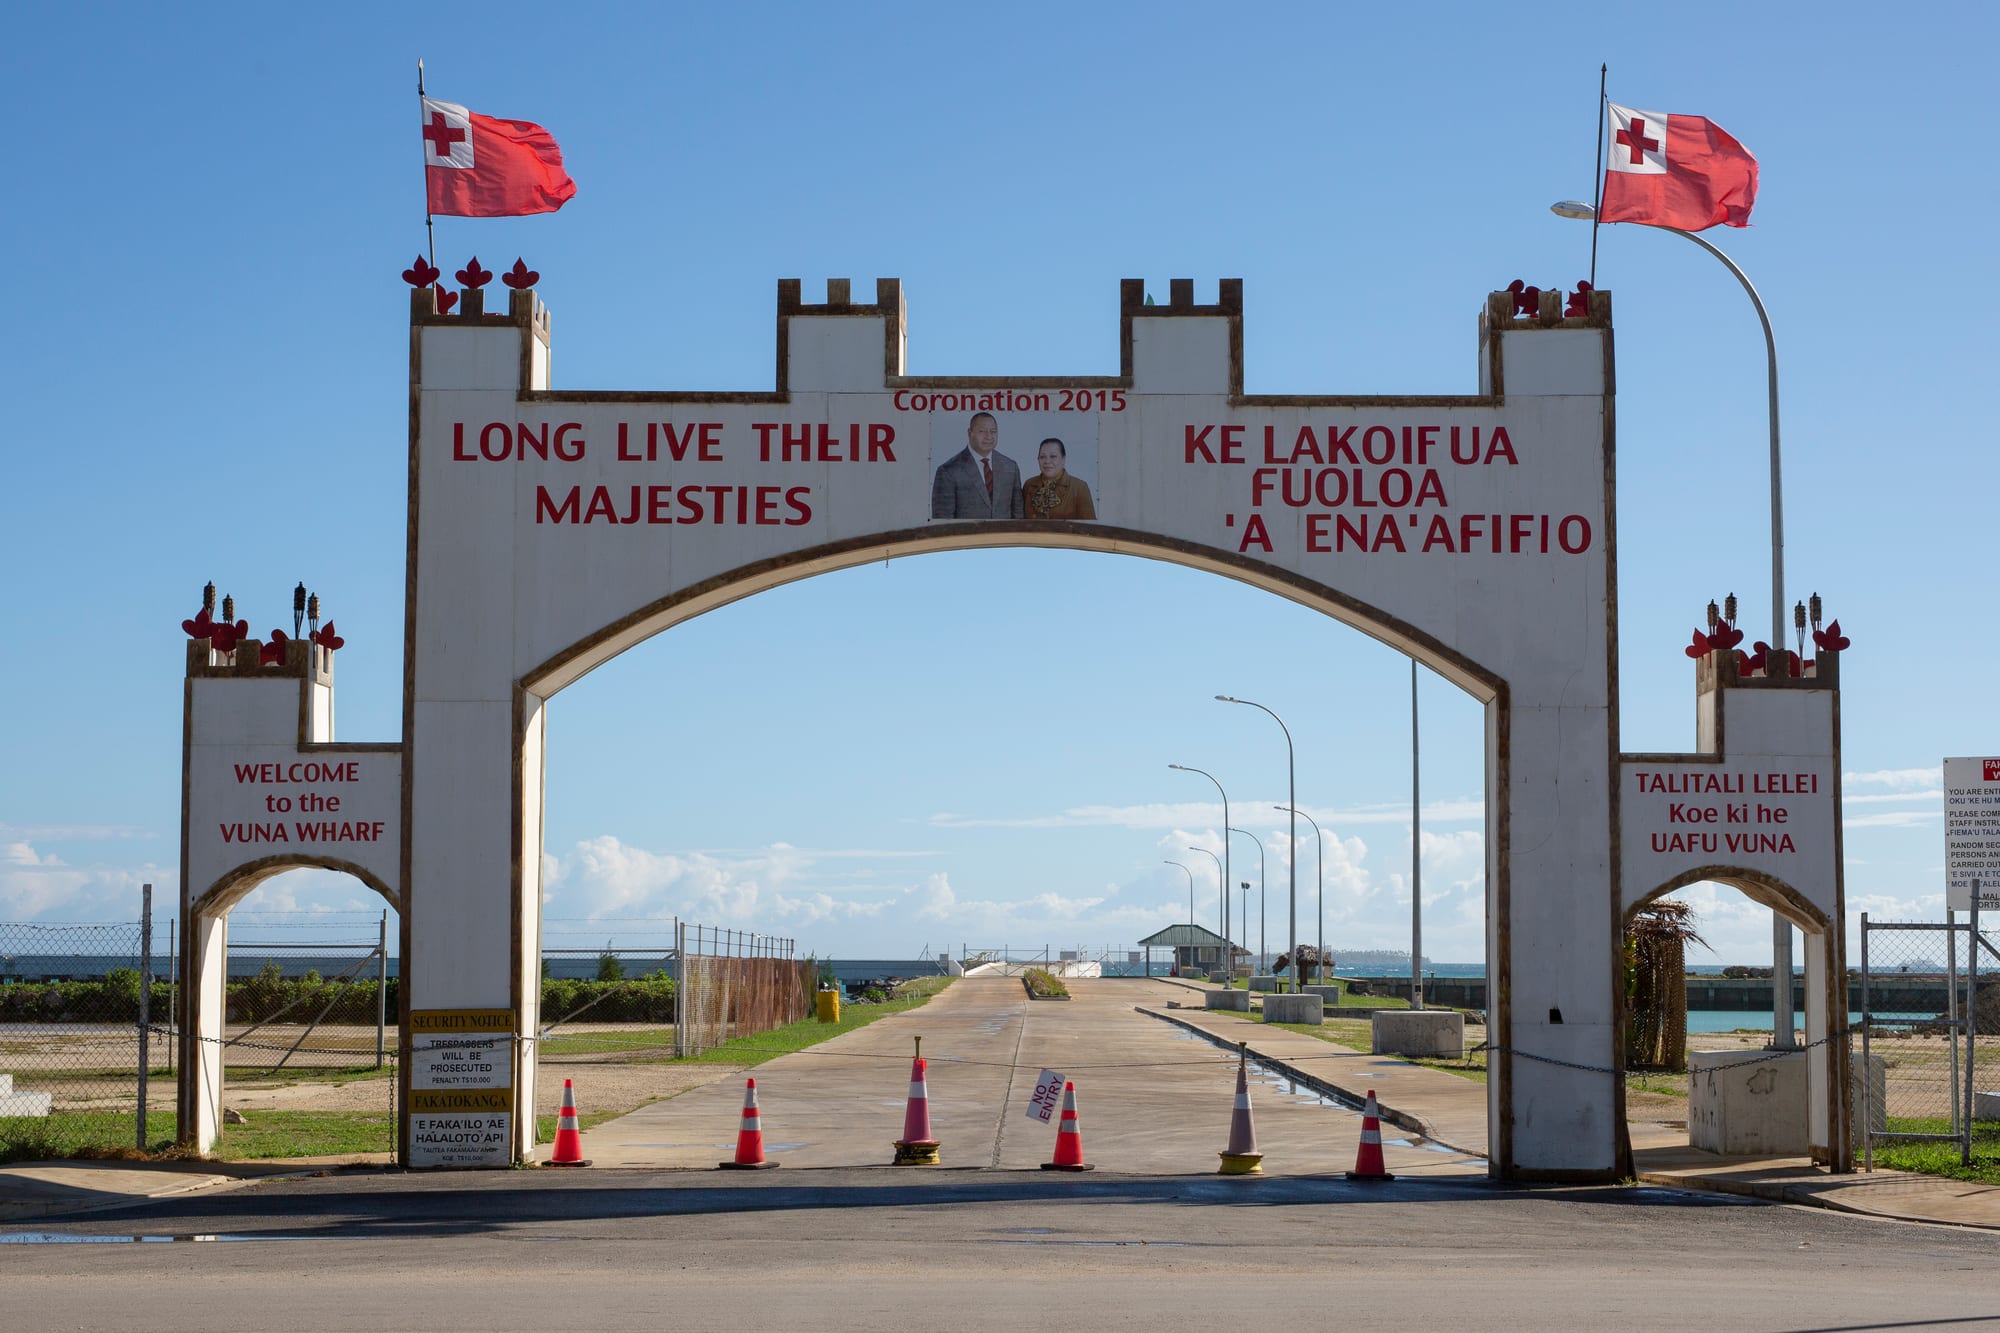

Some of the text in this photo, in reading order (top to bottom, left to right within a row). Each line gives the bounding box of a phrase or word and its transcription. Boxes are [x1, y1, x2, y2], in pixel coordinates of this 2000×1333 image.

[894, 388, 1127, 412] Coronation 2015
[453, 422, 897, 463] LONG LIVE THEIR
[1185, 425, 1518, 465] KE LAKOIFUA
[1252, 468, 1448, 508] FUOLOA
[536, 485, 813, 526] MAJESTIES
[1226, 513, 1592, 555] 'A ENA'AFIFIO
[234, 762, 360, 783] WELCOME
[1635, 773, 1818, 794] TALITALI LELEI
[265, 792, 340, 813] to the
[1669, 803, 1788, 823] Koe ki he
[220, 822, 385, 843] VUNA WHARF
[1651, 833, 1796, 853] UAFU VUNA
[414, 1014, 511, 1028] SECURITY NOTICE
[430, 1039, 494, 1049] TRESPASSERS
[442, 1052, 482, 1060] WILL BE
[430, 1064, 492, 1072] PROSECUTED
[416, 1094, 506, 1108] FAKATOKANGA
[1032, 1084, 1047, 1104] NO
[1040, 1076, 1063, 1121] ENTRY
